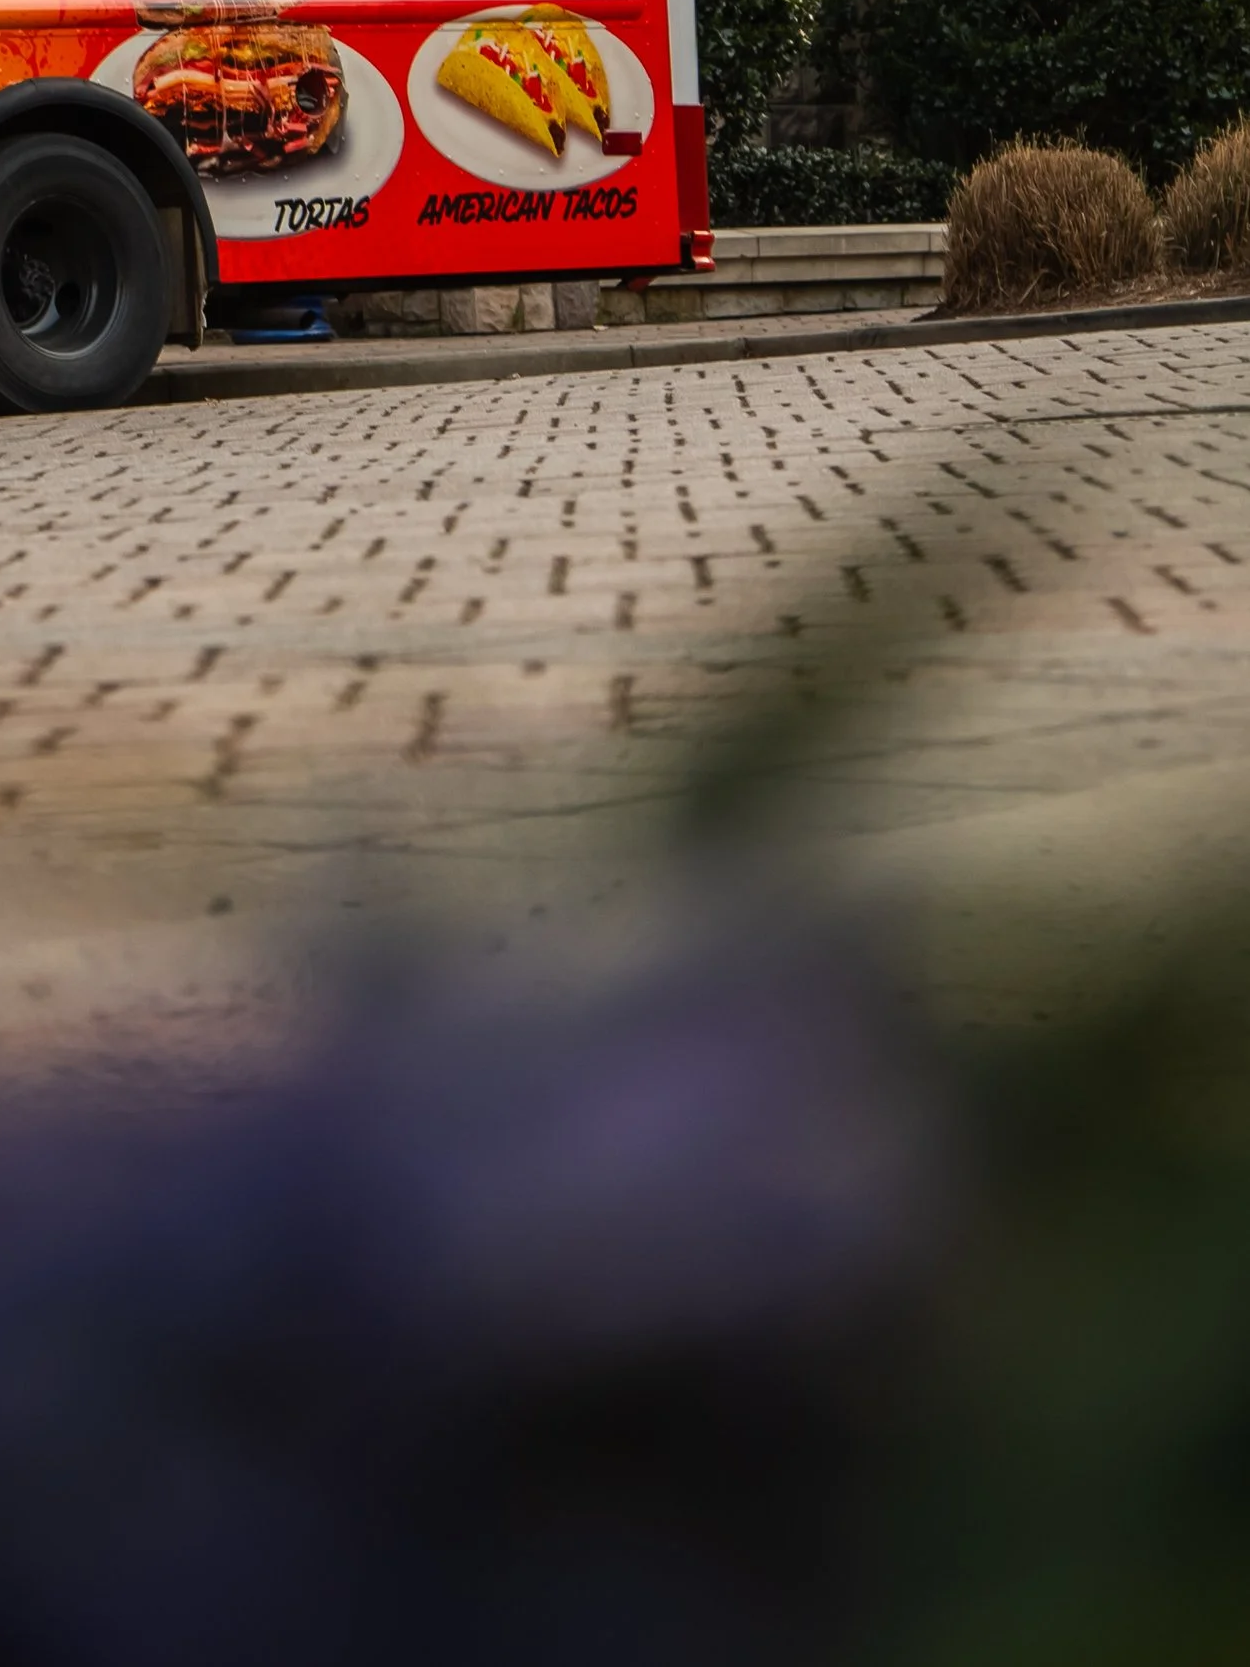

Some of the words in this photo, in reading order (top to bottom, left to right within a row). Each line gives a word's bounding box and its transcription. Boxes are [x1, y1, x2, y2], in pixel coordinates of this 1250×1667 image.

[274, 195, 371, 232] TORTAS
[417, 191, 553, 225] AMERICAN
[560, 187, 638, 221] TACOS
